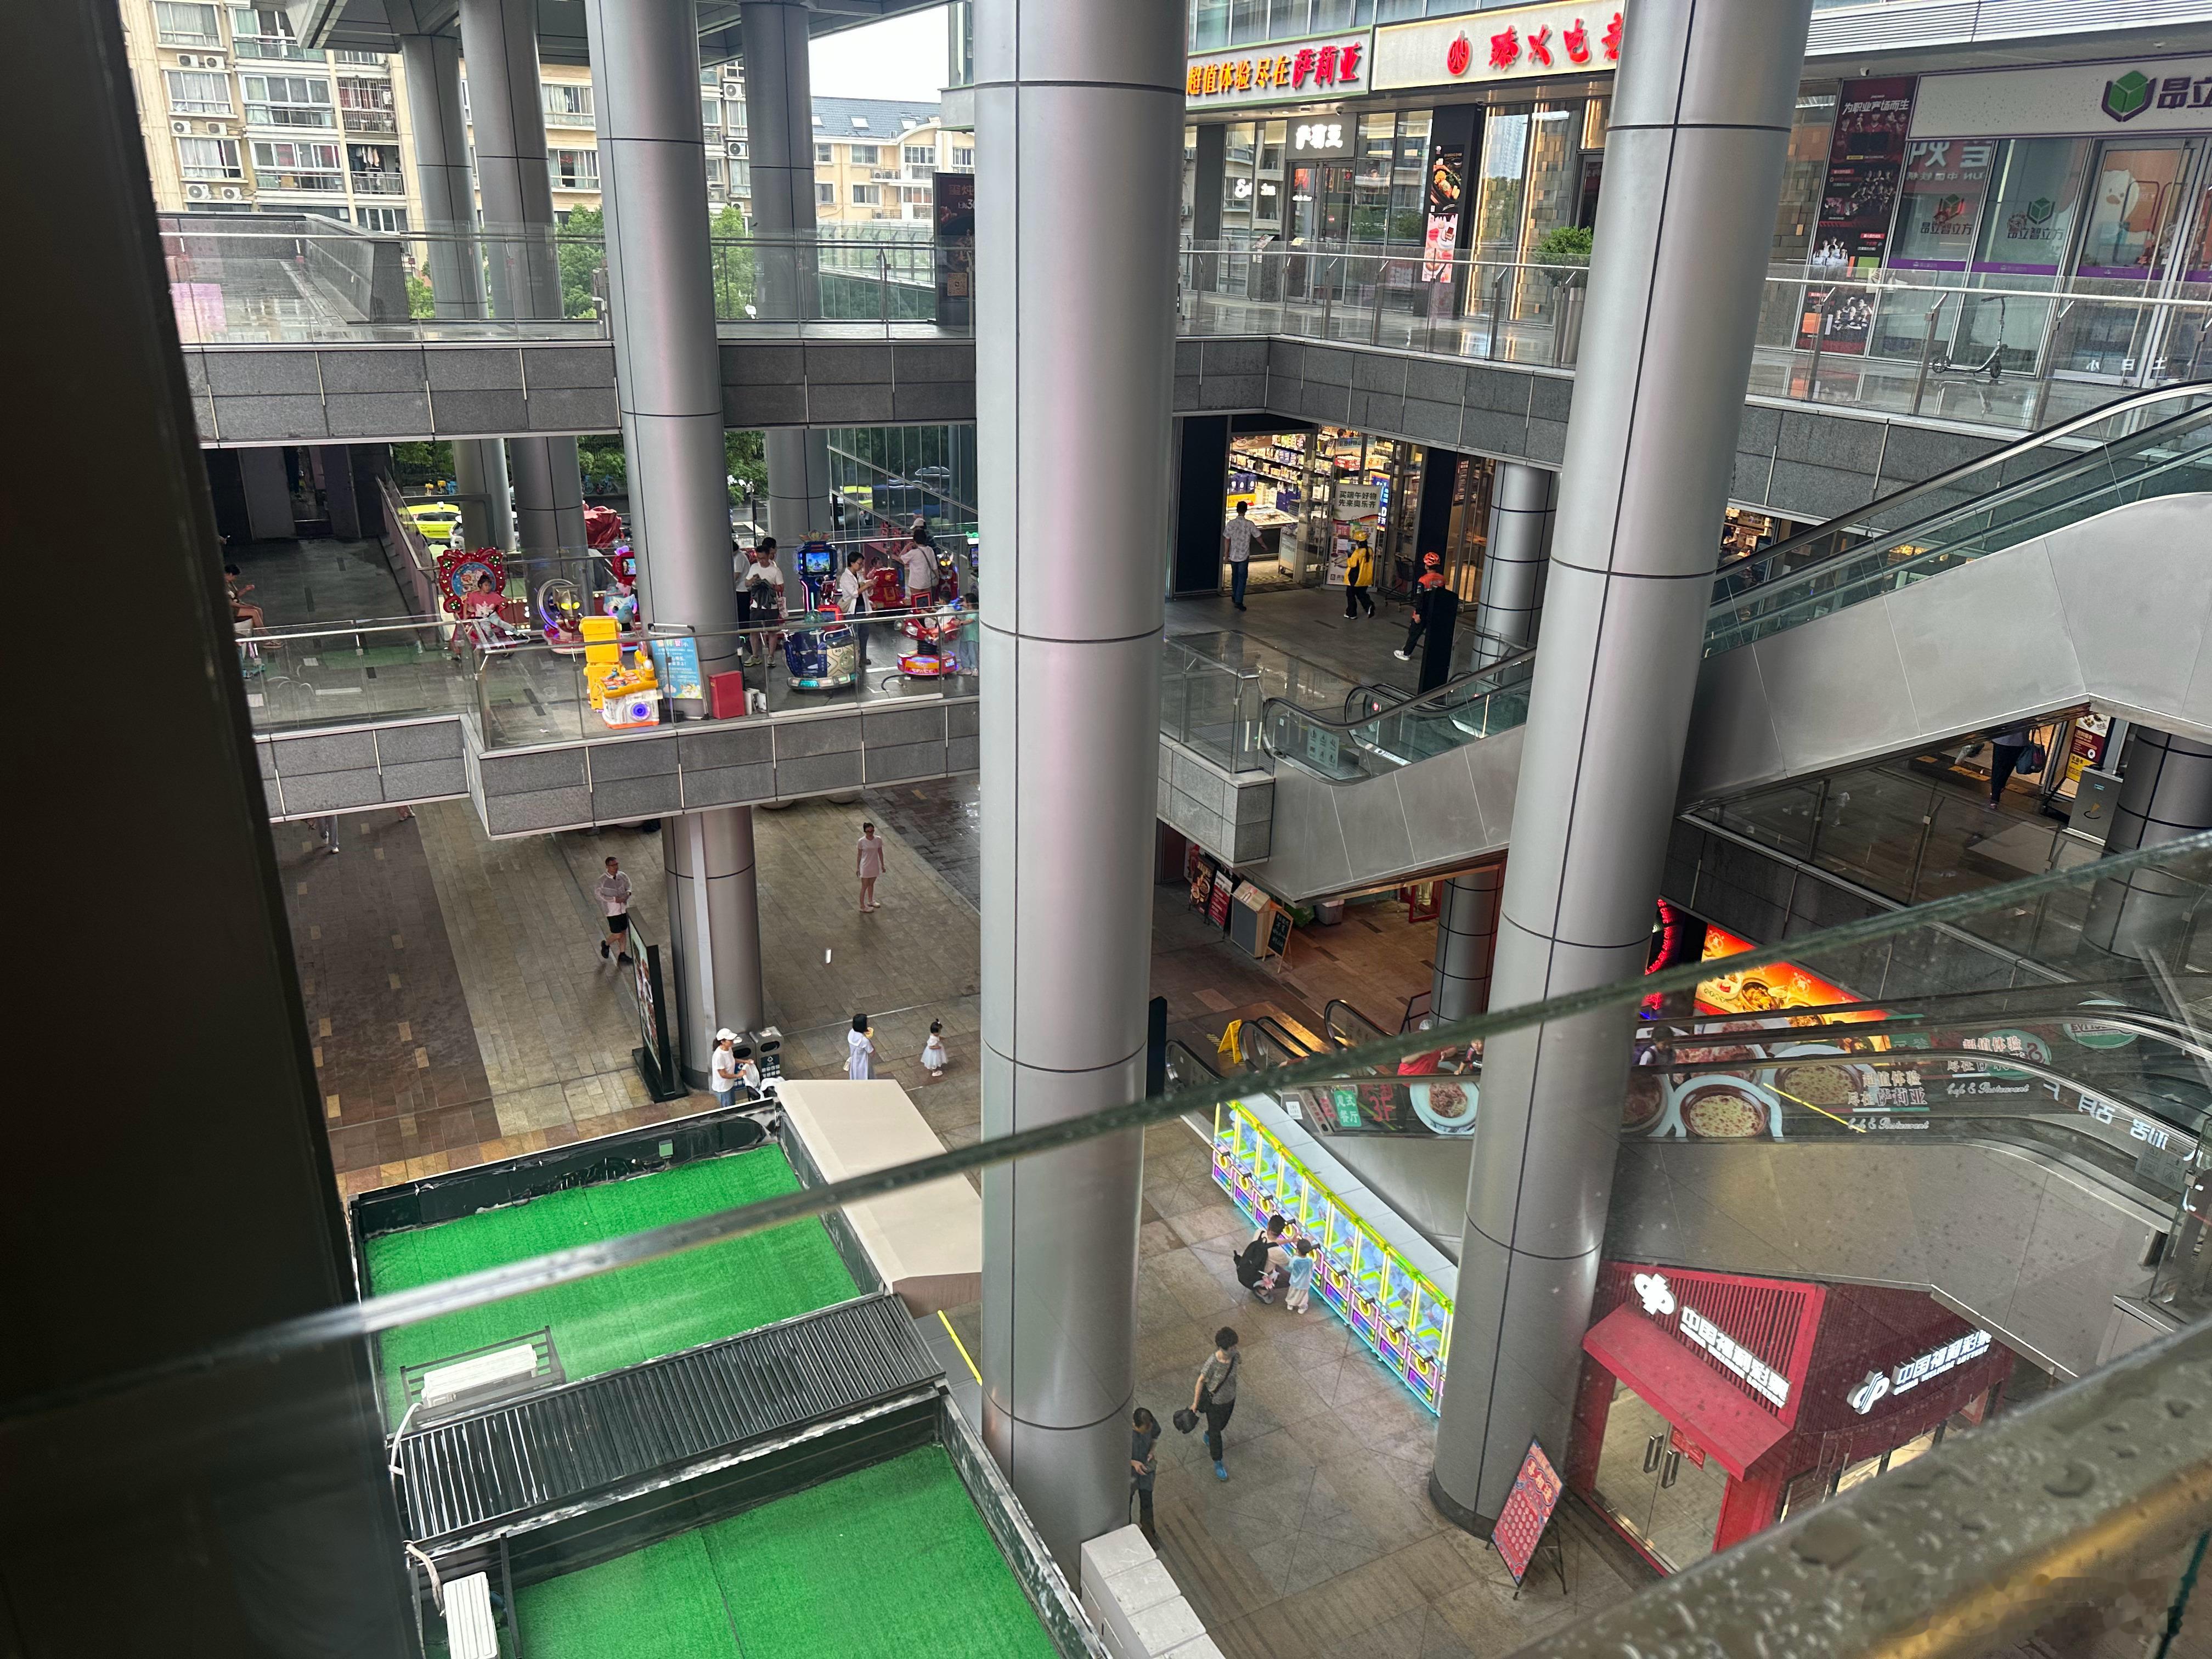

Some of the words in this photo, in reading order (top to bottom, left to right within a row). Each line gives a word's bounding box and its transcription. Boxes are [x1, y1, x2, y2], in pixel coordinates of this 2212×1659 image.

[1920, 222, 1973, 235] 昂立智立方
[1339, 490, 1376, 500] 买端午好物
[1339, 499, 1376, 509] 先来奥乐齐
[1962, 1035, 2023, 1052] 超值体验
[1862, 1070, 1922, 1087] 超值体验
[1848, 1087, 1928, 1107] 尽在萨莉亚
[1340, 1110, 1359, 1124] 餐厅
[1897, 1329, 1992, 1385] 中国福利彩票
